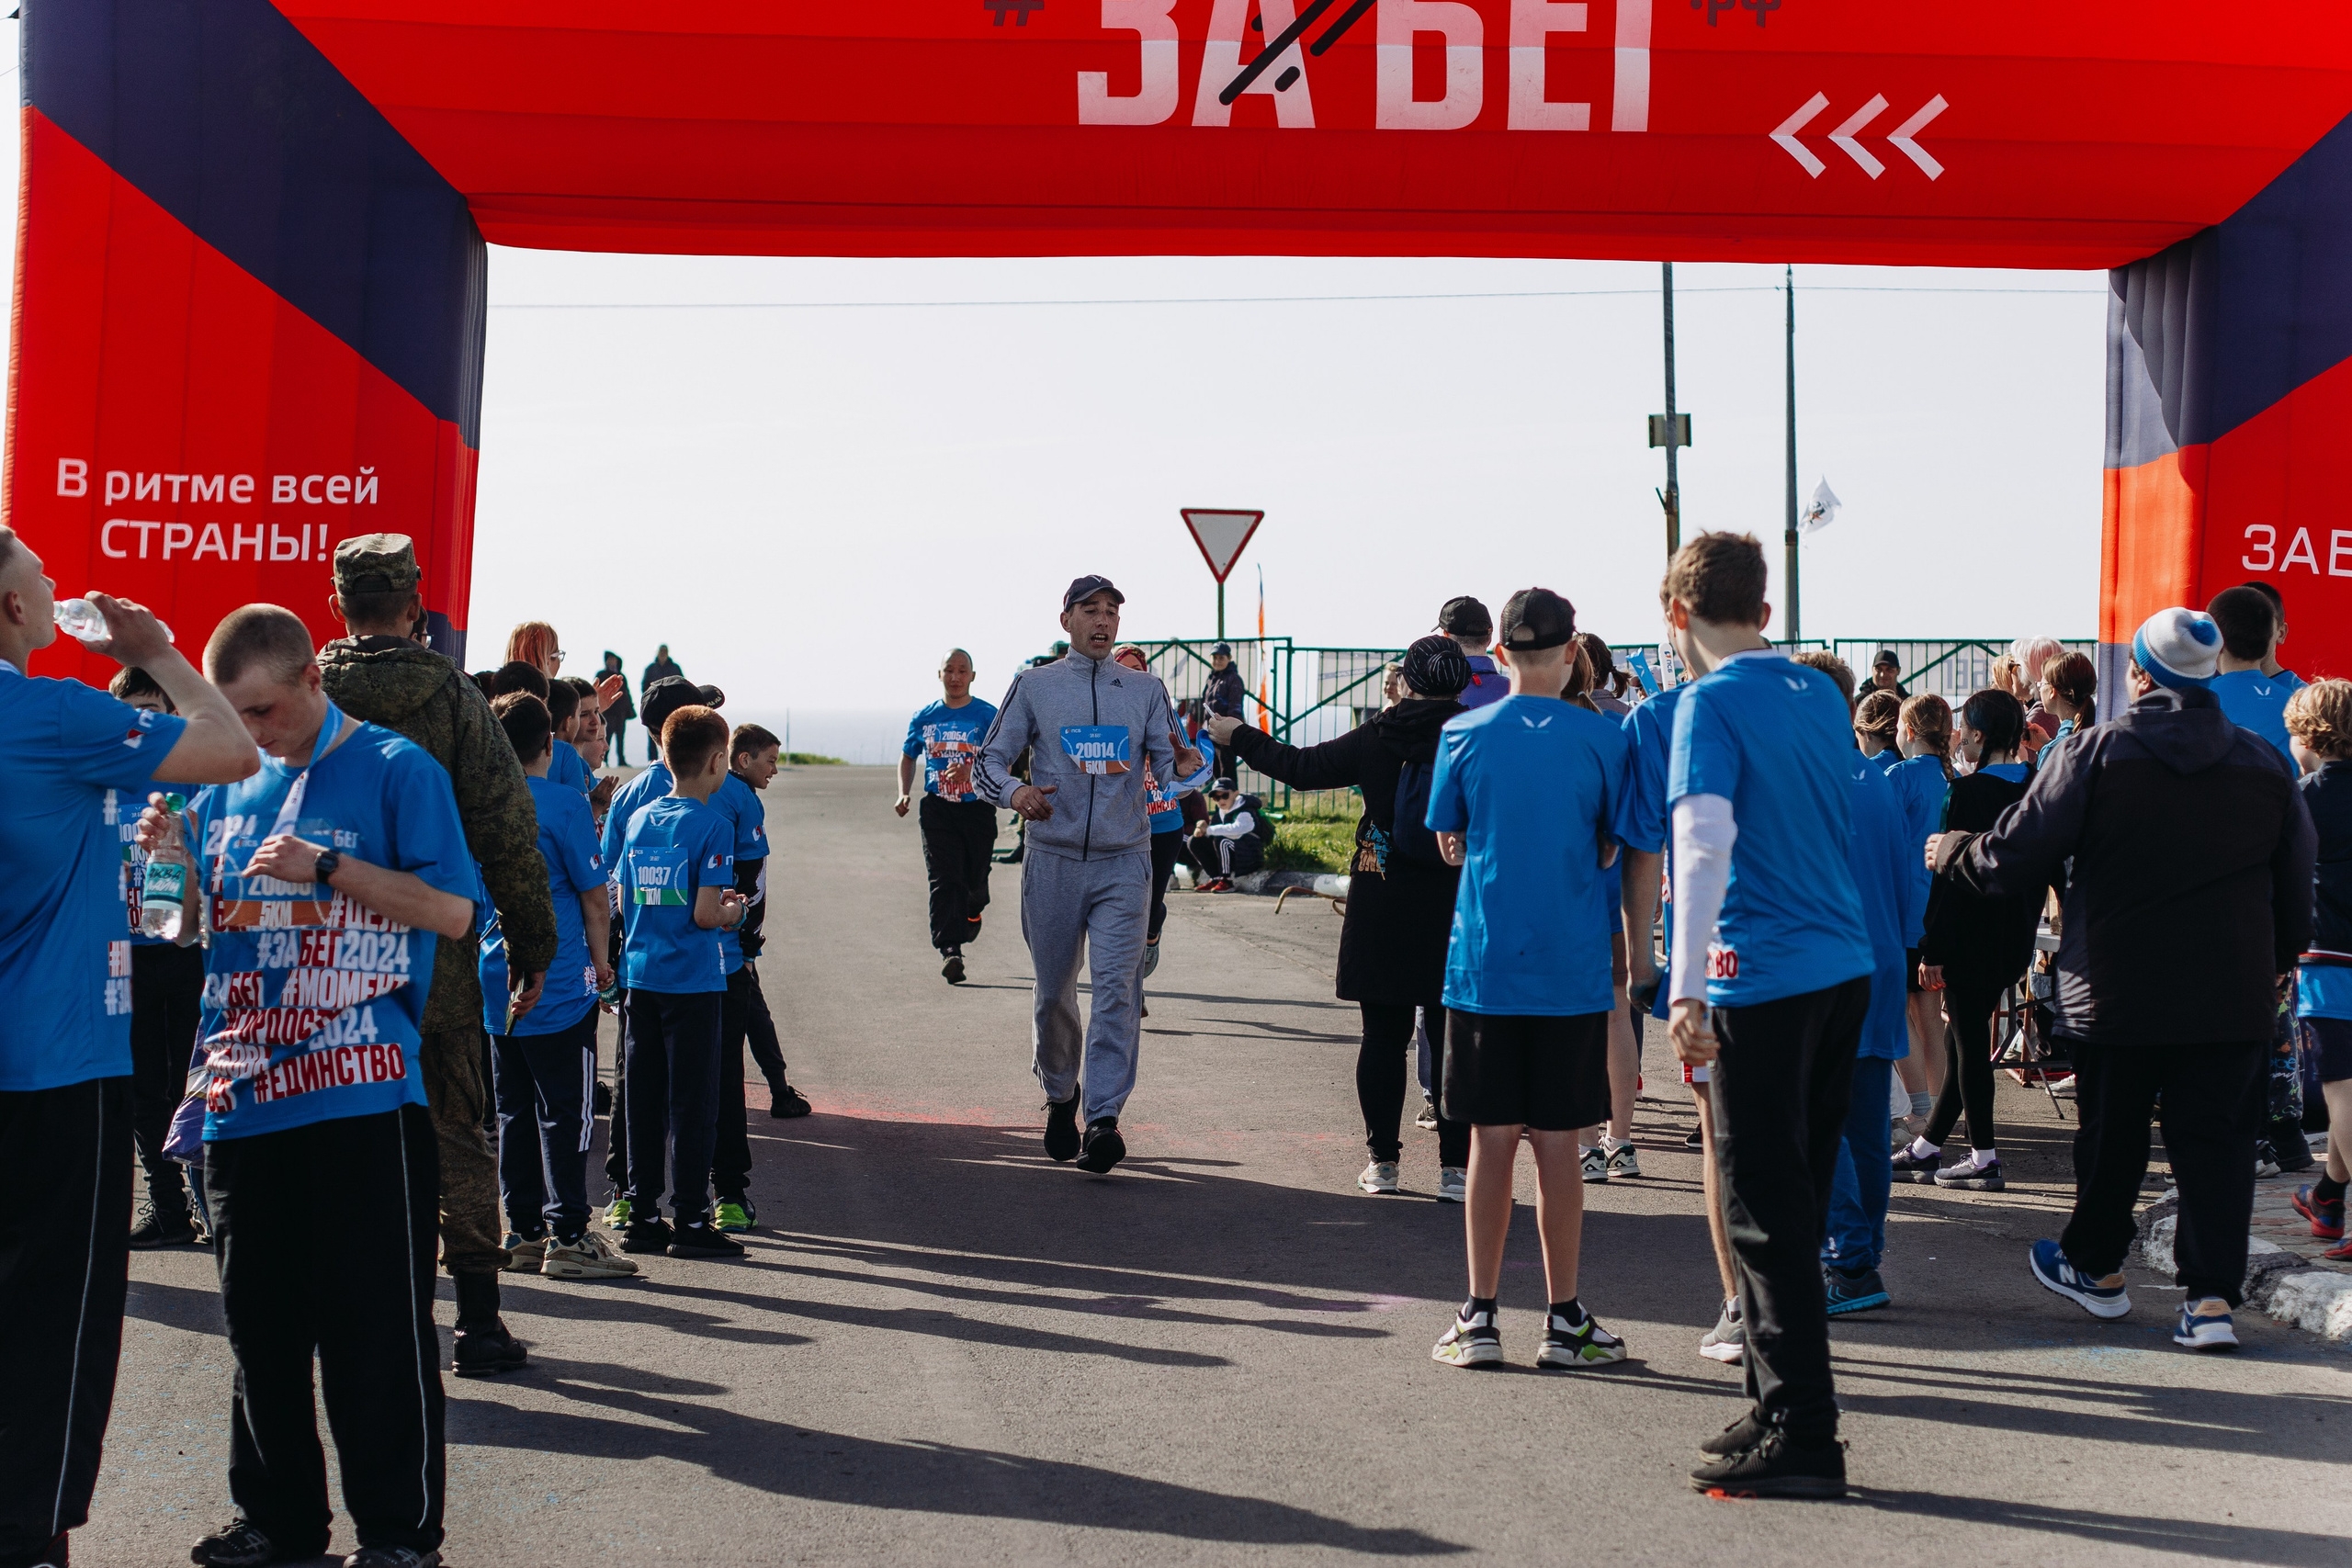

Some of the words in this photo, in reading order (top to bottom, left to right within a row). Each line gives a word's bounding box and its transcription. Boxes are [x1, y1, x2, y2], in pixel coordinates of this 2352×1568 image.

[56, 457, 89, 498] В
[104, 469, 255, 506] ритме
[271, 466, 379, 505] всей
[100, 518, 328, 562] СТРАНЫ!
[942, 730, 967, 742] 20054
[1075, 741, 1115, 759] 20014
[637, 865, 672, 886] 10037
[256, 930, 412, 974] #ЗАБЕГ2024
[254, 1043, 406, 1103] #ЕДИНСТВО
